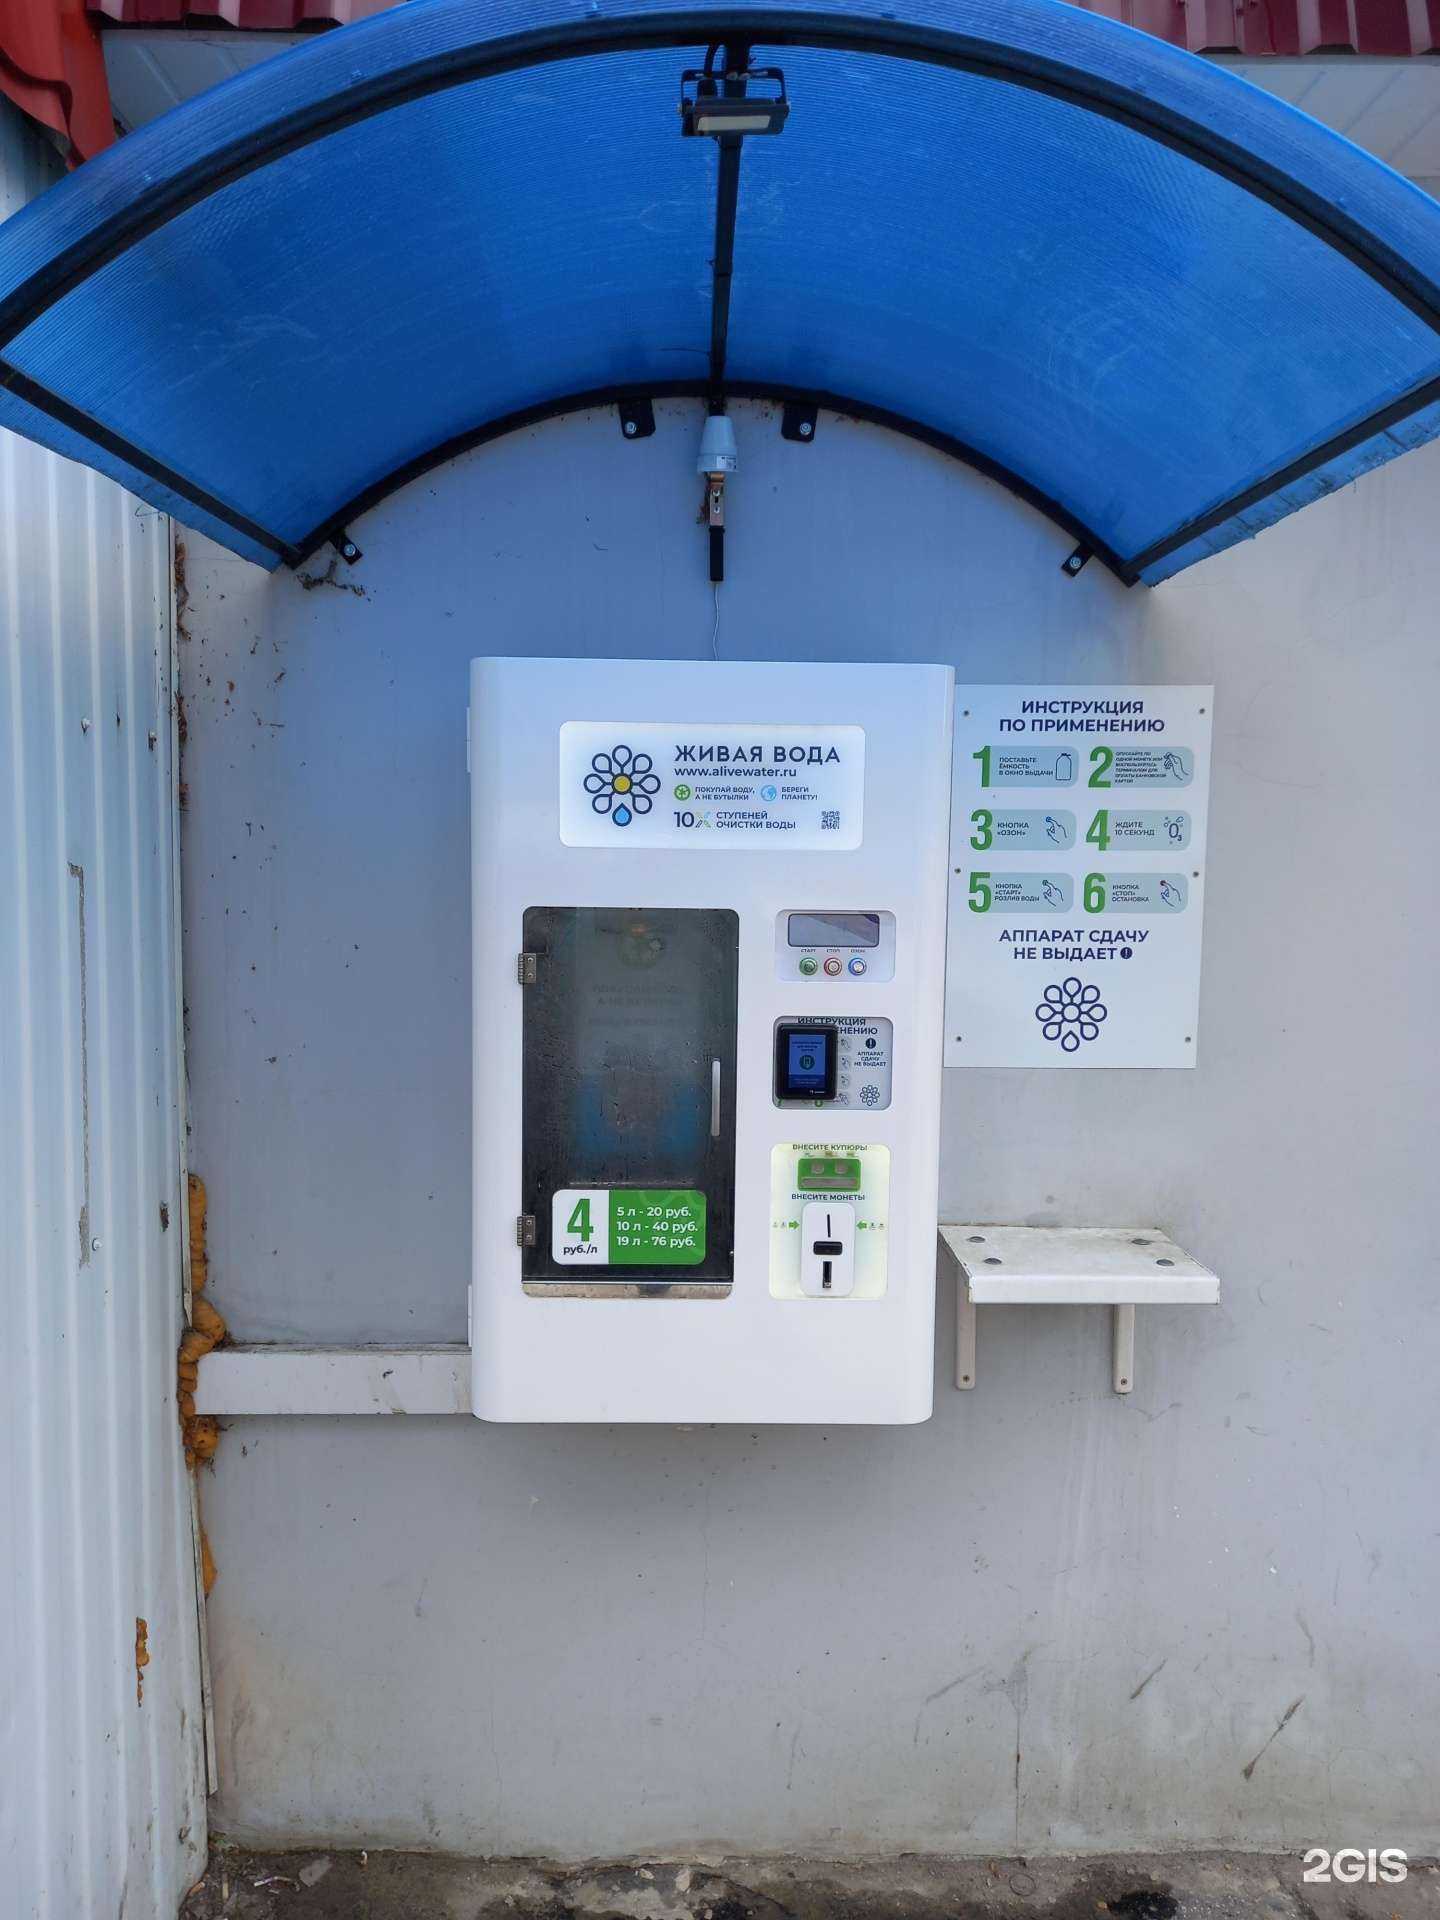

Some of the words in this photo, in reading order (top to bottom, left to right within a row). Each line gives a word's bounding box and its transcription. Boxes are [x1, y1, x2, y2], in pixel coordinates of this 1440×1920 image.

[1021, 701, 1144, 716] ИНСТРУКЦИЯ
[1000, 719, 1026, 732] ПО
[1031, 719, 1164, 732] ПРИМЕНЕНИЮ
[674, 744, 763, 762] ЖИВАЯ
[773, 746, 840, 765] ВОДА
[674, 766, 797, 777] www.alivewater.ru
[973, 745, 991, 788] 1
[1088, 746, 1111, 788] 2
[733, 786, 755, 794] ВОДУ,
[713, 793, 749, 801] БУТЫЛКИ
[782, 793, 818, 801] ПЛАНЕТУ!
[716, 810, 768, 820] СТУПЕНЕЙ
[716, 821, 763, 829] ОЧИСТКИ
[766, 821, 796, 829] ВОДЫ
[970, 809, 993, 851] 3
[1085, 810, 1111, 851] 4
[968, 872, 992, 913] 5
[1083, 873, 1107, 913] 6
[999, 930, 1084, 942] АППАРАТ
[1089, 930, 1149, 944] СДАЧУ
[1013, 947, 1037, 959] НЕ
[798, 1017, 865, 1025] ИНСТРУКЦИЯ
[617, 1207, 624, 1216] 5
[627, 1208, 636, 1216] л
[647, 1207, 662, 1216] 20
[665, 1207, 691, 1218] руб.
[567, 1198, 594, 1242] 4
[617, 1222, 629, 1231] 10
[632, 1223, 641, 1231] л
[652, 1222, 668, 1231] 40
[672, 1221, 698, 1233] руб.
[617, 1236, 629, 1246] 19
[632, 1238, 641, 1246] л
[651, 1236, 667, 1246] 76
[670, 1236, 695, 1248] руб.
[563, 1244, 598, 1255] руб./л
